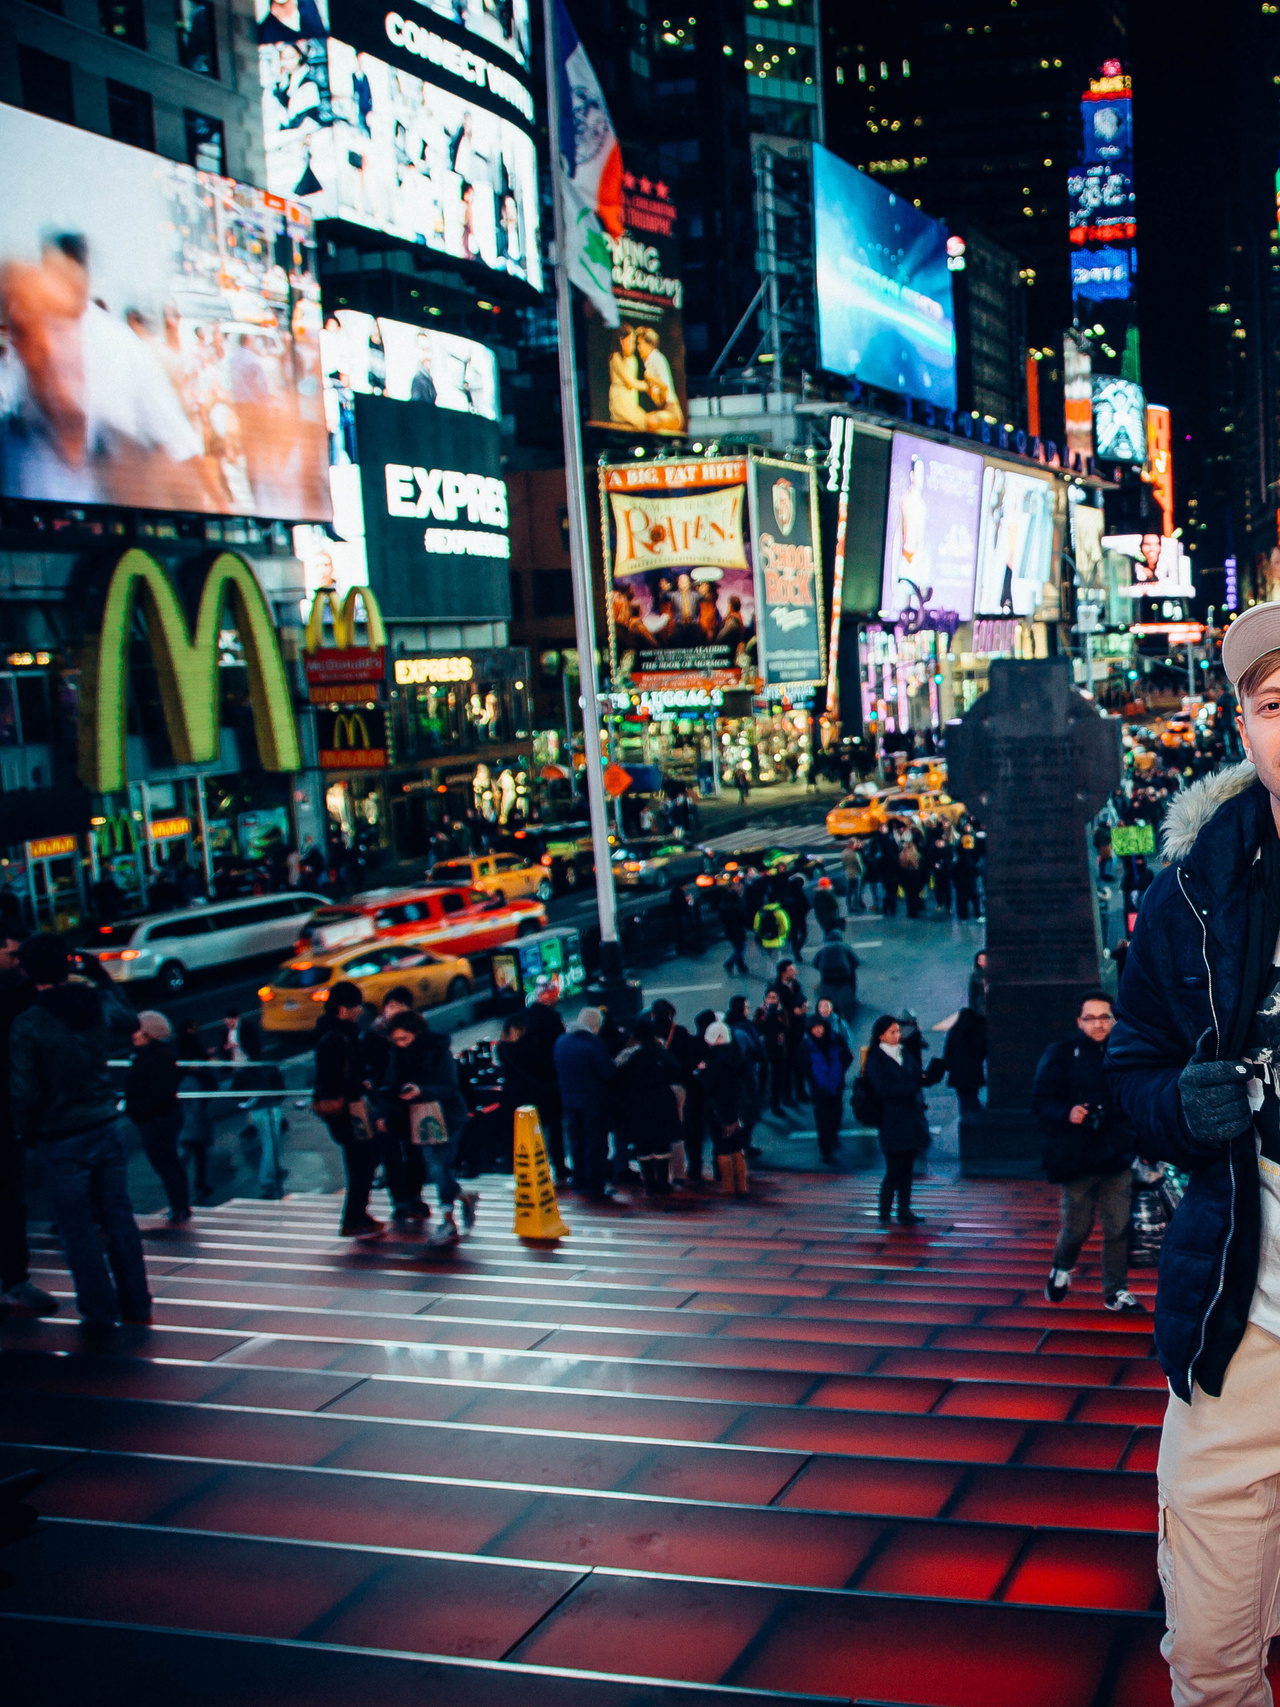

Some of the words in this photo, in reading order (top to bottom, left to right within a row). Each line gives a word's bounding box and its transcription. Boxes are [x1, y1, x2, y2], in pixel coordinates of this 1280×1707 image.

[665, 465, 697, 482] FAT
[758, 532, 814, 572] SCHOOL
[764, 569, 814, 605] ROCK
[394, 657, 473, 685] EXPRESS
